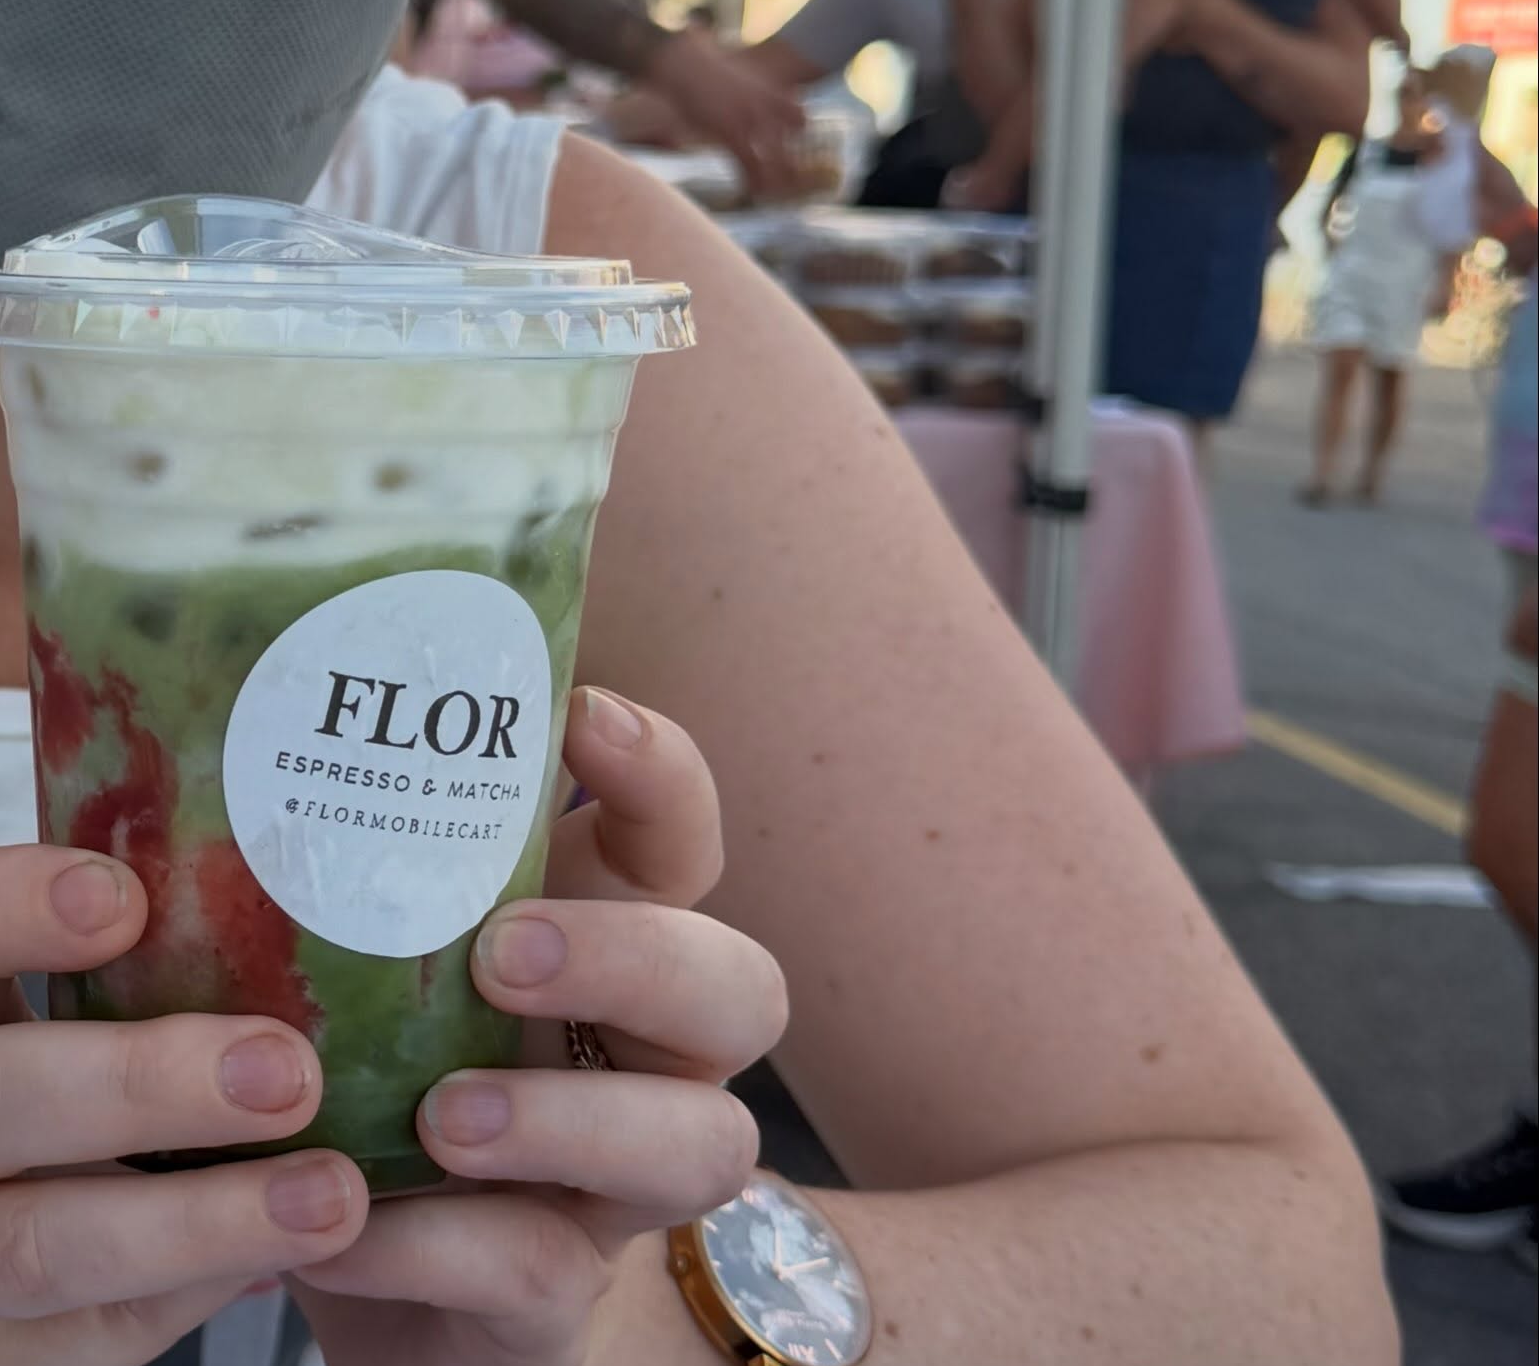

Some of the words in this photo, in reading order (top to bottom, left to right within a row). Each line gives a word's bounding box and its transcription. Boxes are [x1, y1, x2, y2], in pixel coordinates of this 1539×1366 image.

[314, 671, 520, 758] FLOR
[275, 751, 411, 793] ESPRESSO
[421, 778, 437, 796] &
[446, 780, 520, 800] MATCHA
[285, 797, 503, 841] @FLORMOBILECART
